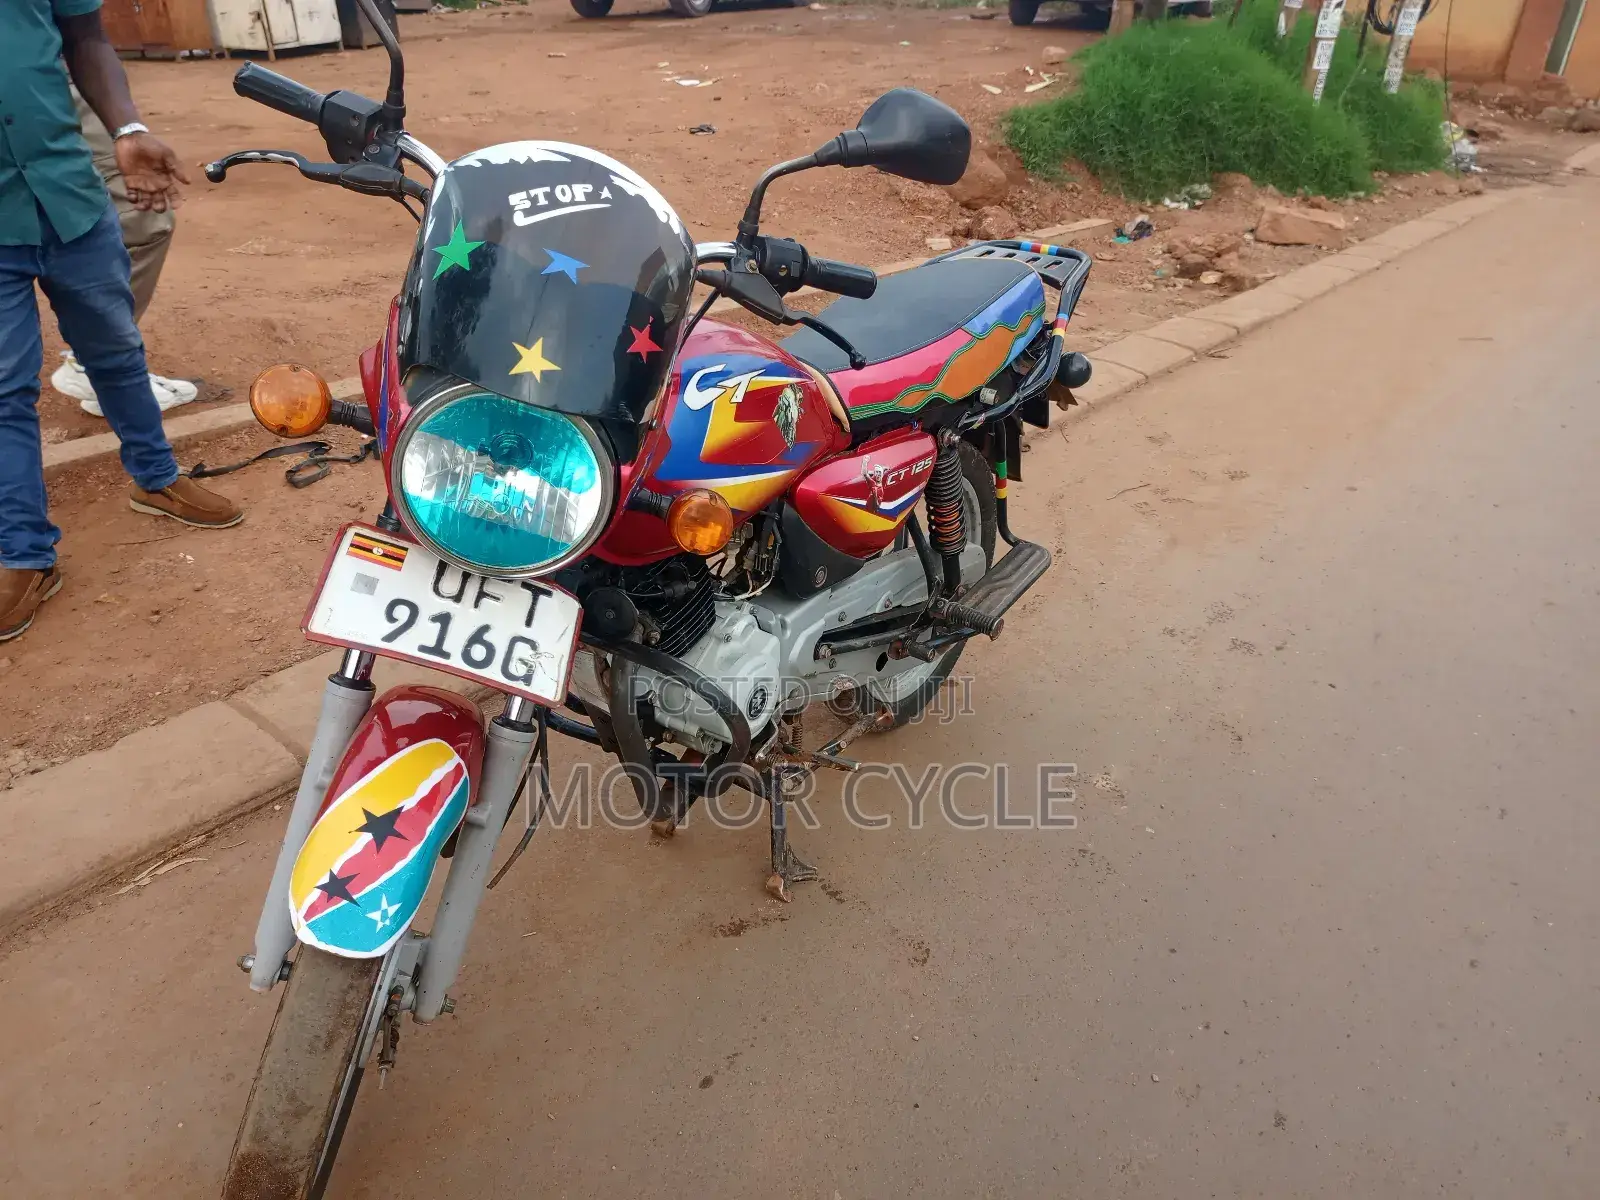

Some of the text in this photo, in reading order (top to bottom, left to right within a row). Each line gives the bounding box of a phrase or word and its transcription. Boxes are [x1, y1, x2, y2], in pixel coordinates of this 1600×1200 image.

[508, 184, 593, 211] STOP
[683, 363, 766, 412] CT
[886, 456, 934, 486] CT 125
[433, 558, 554, 628] UFT
[381, 598, 539, 687] 916G
